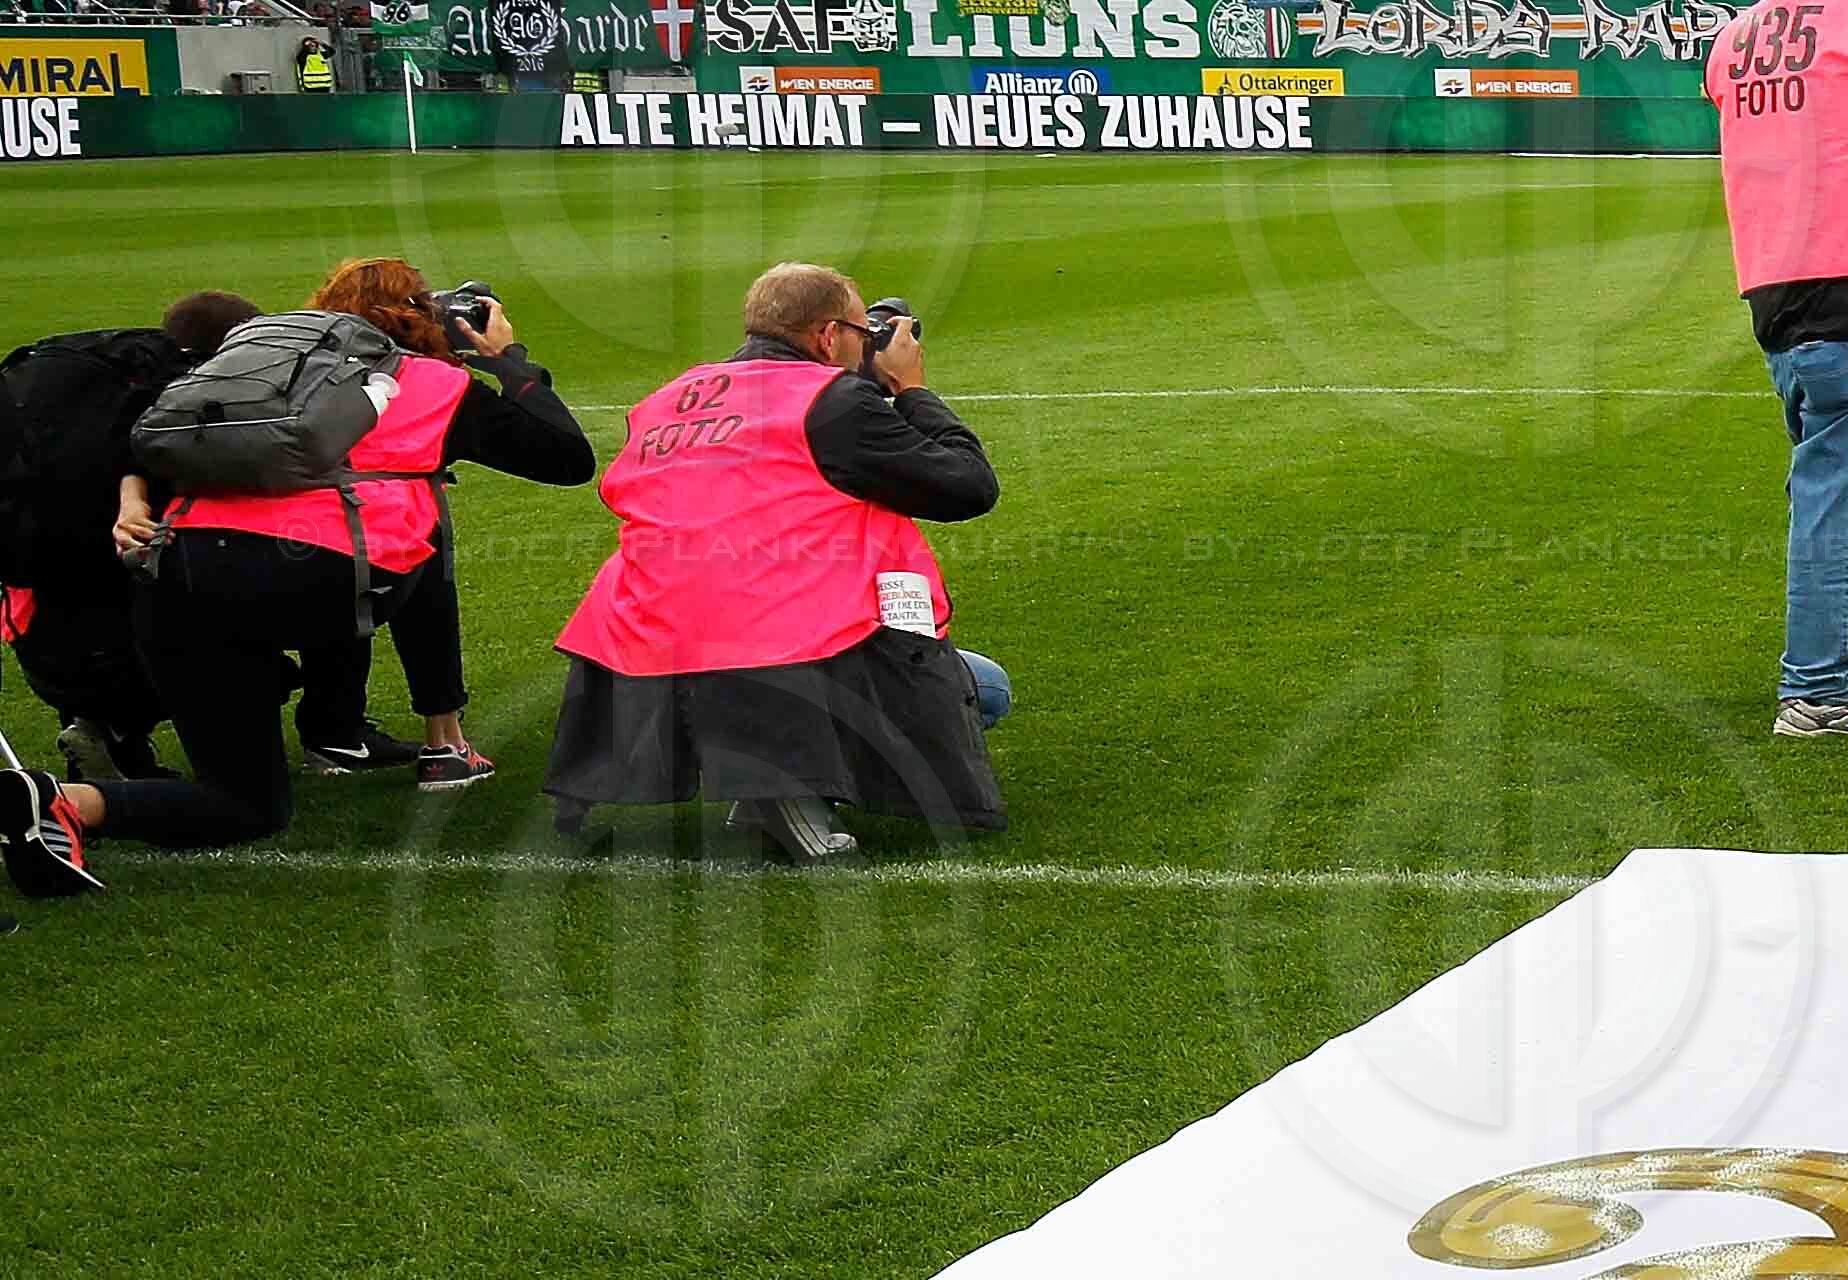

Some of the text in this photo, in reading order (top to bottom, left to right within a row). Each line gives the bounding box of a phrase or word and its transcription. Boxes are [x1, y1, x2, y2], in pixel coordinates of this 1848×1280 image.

[1729, 5, 1825, 80] 935
[779, 78, 875, 91] WIEN ENERGIE
[984, 73, 1065, 95] Allianz
[1239, 73, 1335, 94] Ottakringer
[1476, 81, 1572, 94] WIEN ENERGIE
[1735, 75, 1805, 118] FOTO
[561, 93, 1313, 149] ALTE HEIMAT NEUES ZUHAUSE
[639, 414, 745, 465] FOTO
